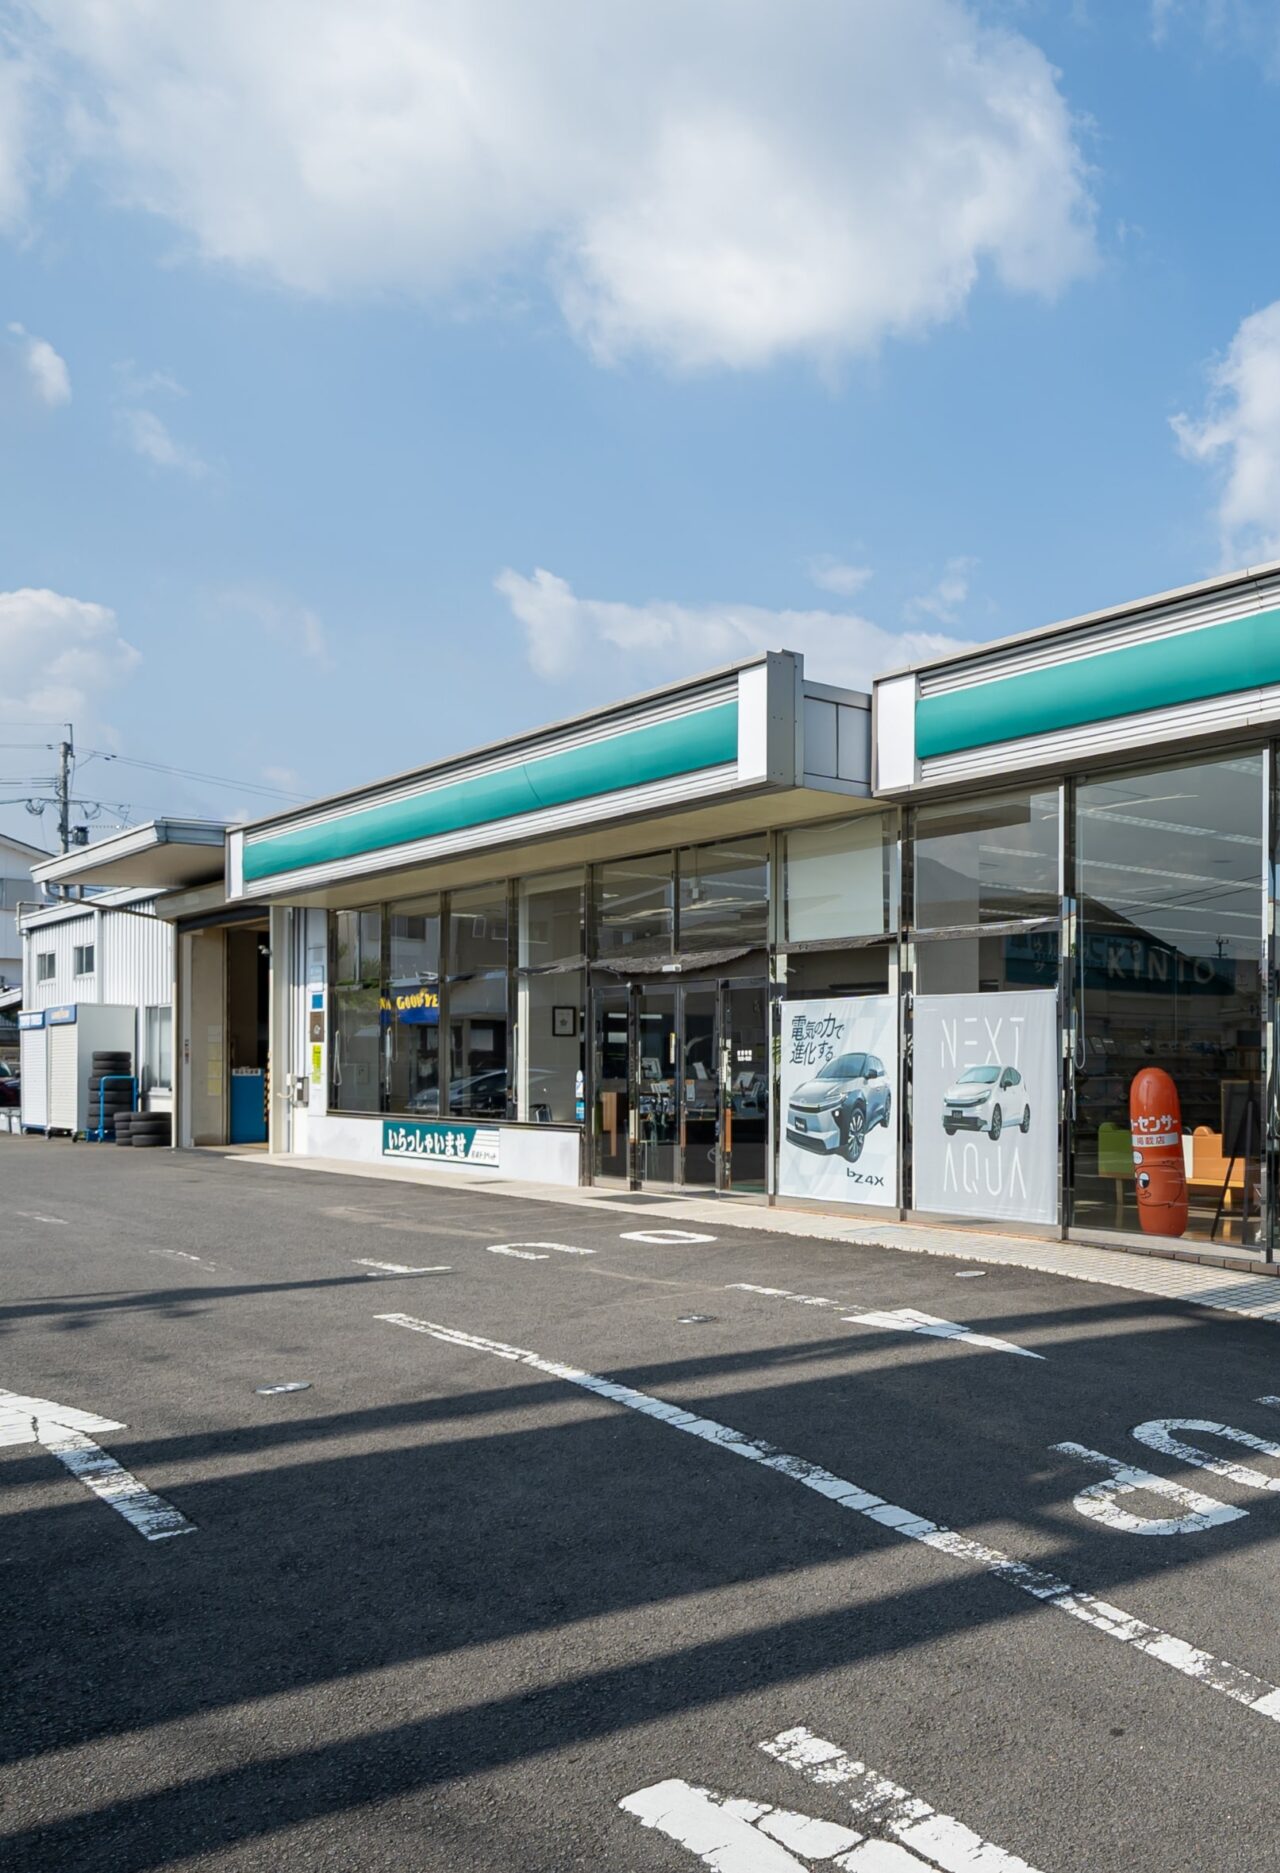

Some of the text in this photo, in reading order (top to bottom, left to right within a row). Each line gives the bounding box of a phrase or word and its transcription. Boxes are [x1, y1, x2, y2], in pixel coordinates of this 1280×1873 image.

[792, 1012, 845, 1042] 電気の力で
[789, 1041, 835, 1067] 進化する
[941, 1016, 1025, 1069] NEXT
[388, 1128, 467, 1158] いらっしゃいませ
[846, 1167, 884, 1187] bZ4X
[942, 1143, 1027, 1199] AQUA
